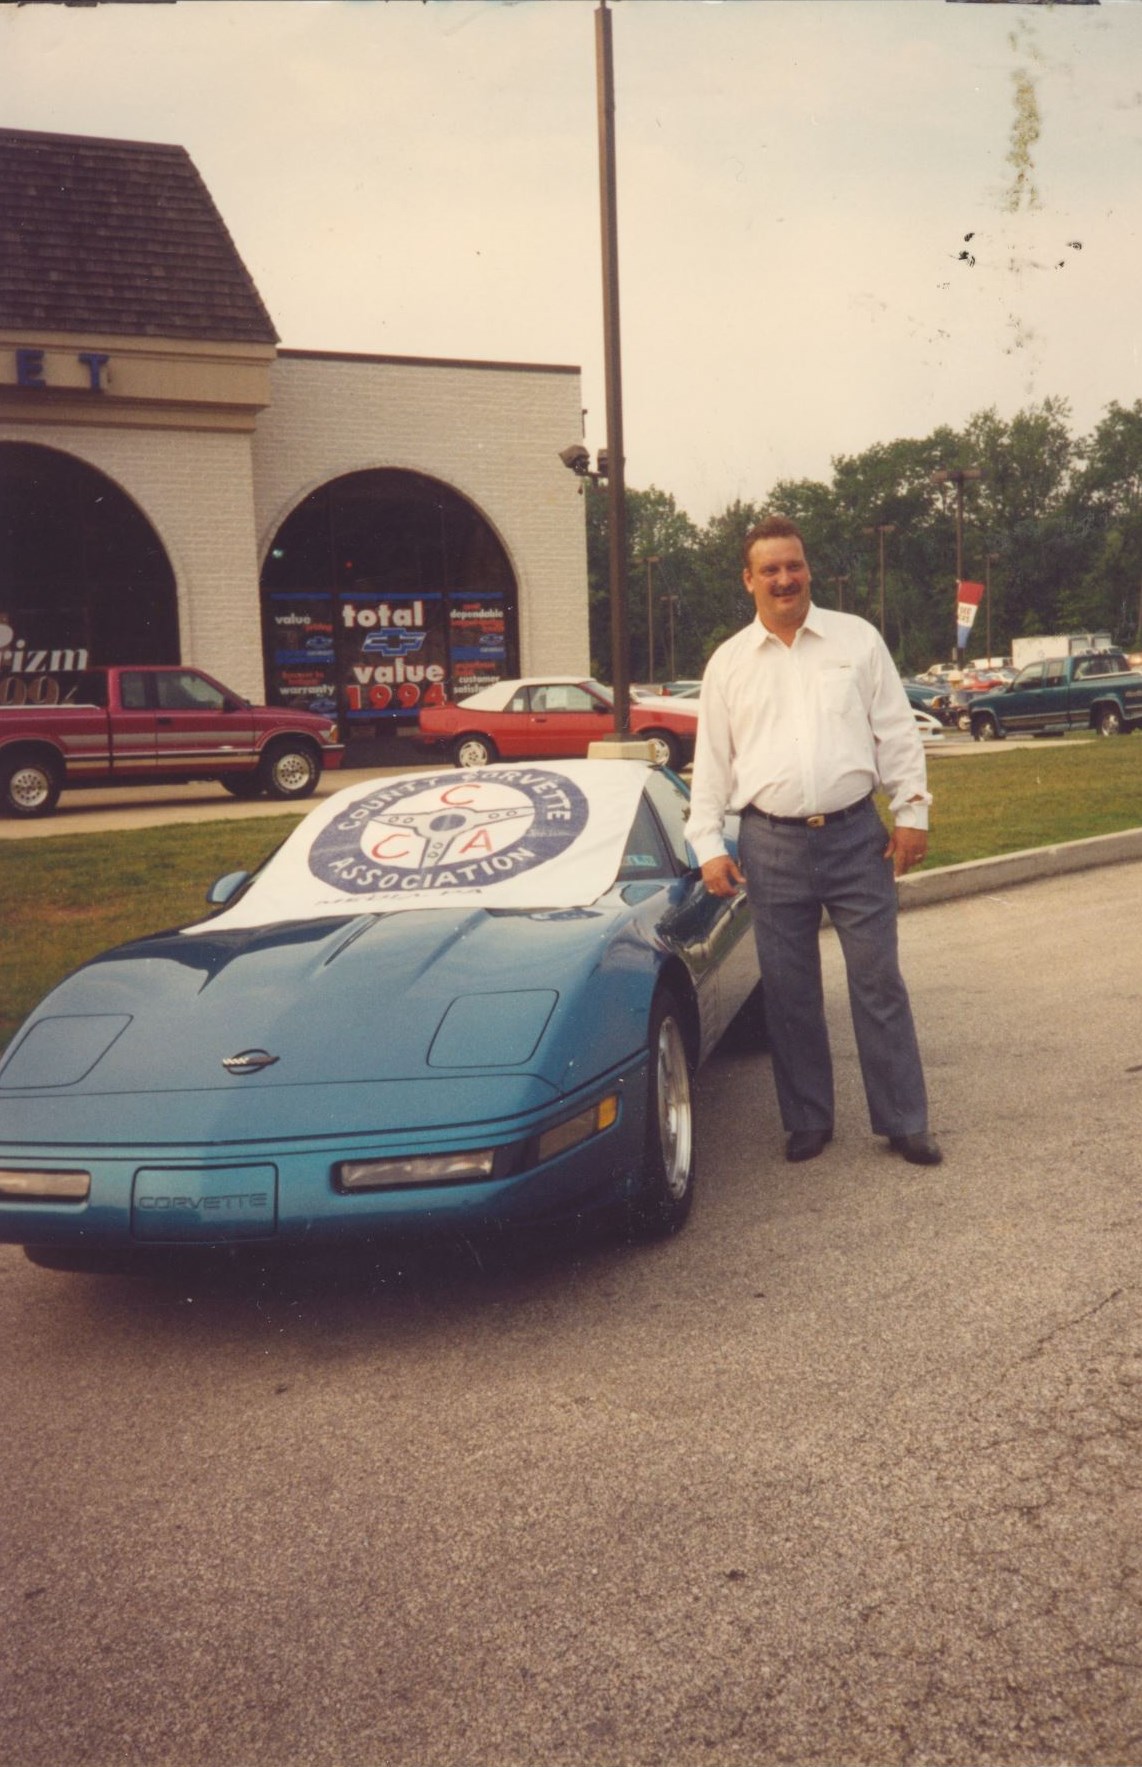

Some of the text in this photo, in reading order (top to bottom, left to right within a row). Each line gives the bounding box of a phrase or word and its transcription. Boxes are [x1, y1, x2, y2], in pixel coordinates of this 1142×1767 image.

[15, 347, 110, 393] ET
[275, 612, 311, 625] value
[342, 601, 424, 628] total
[449, 608, 504, 620] dependable
[353, 658, 445, 684] value
[458, 674, 500, 684] customer
[279, 684, 336, 697] warranty
[346, 682, 448, 710] 1994
[338, 777, 439, 831] COUNTY
[440, 783, 482, 806] C
[371, 828, 493, 860] C A
[328, 848, 535, 890] ASSOCIATION
[139, 1192, 267, 1210] CORVETTE
